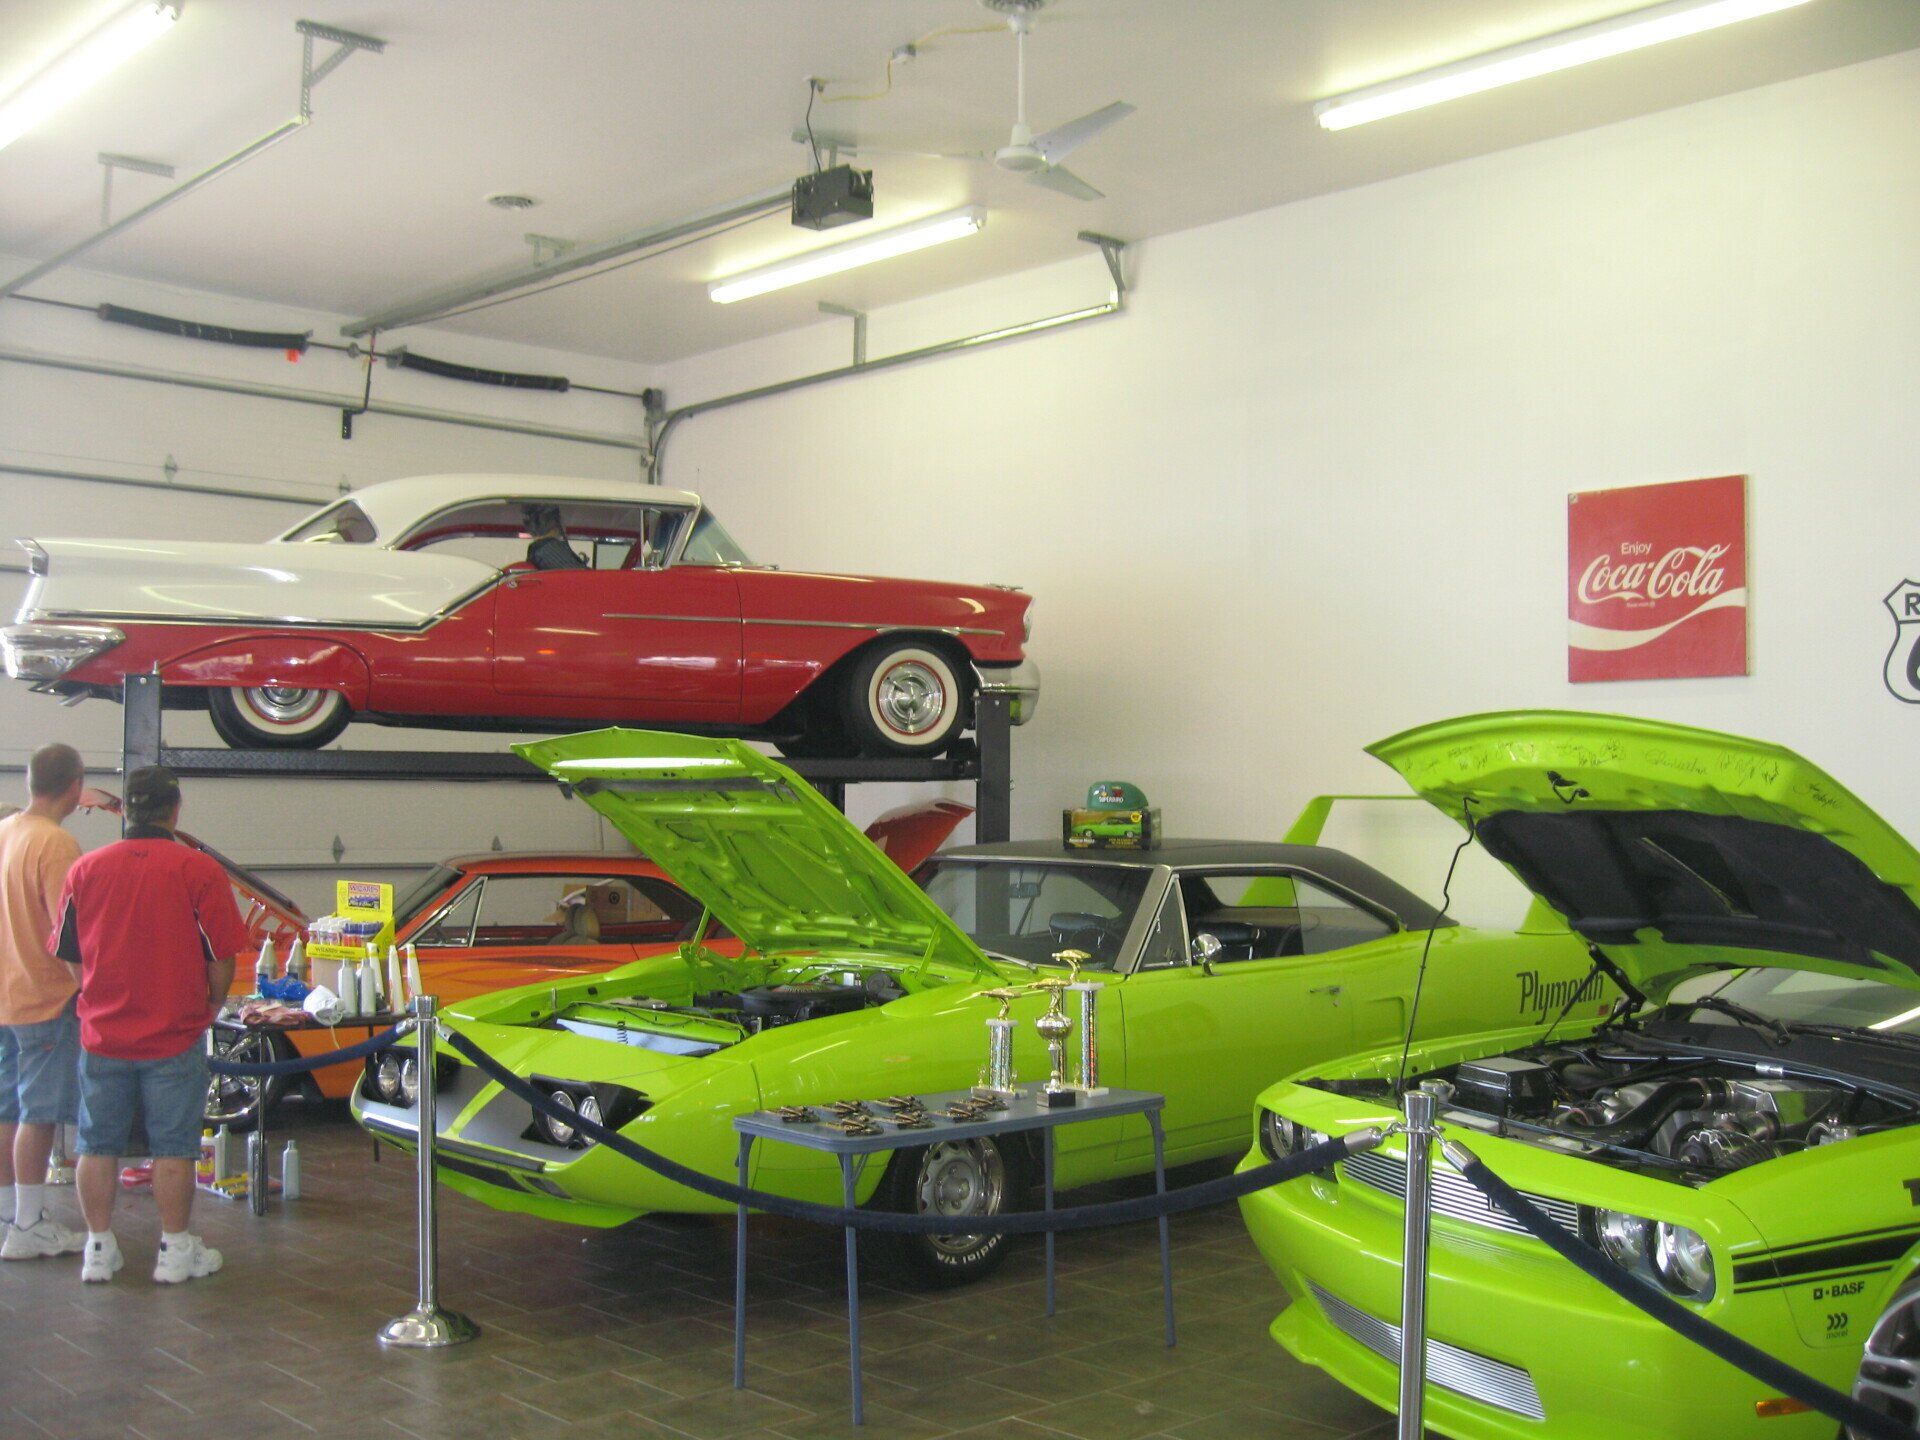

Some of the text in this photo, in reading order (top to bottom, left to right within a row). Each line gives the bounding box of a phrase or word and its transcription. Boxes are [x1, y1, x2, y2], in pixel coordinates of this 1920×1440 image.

[1621, 542, 1652, 556] Enjoy
[1577, 543, 1732, 605] Coca-Cola
[1831, 1281, 1865, 1297] BASF
